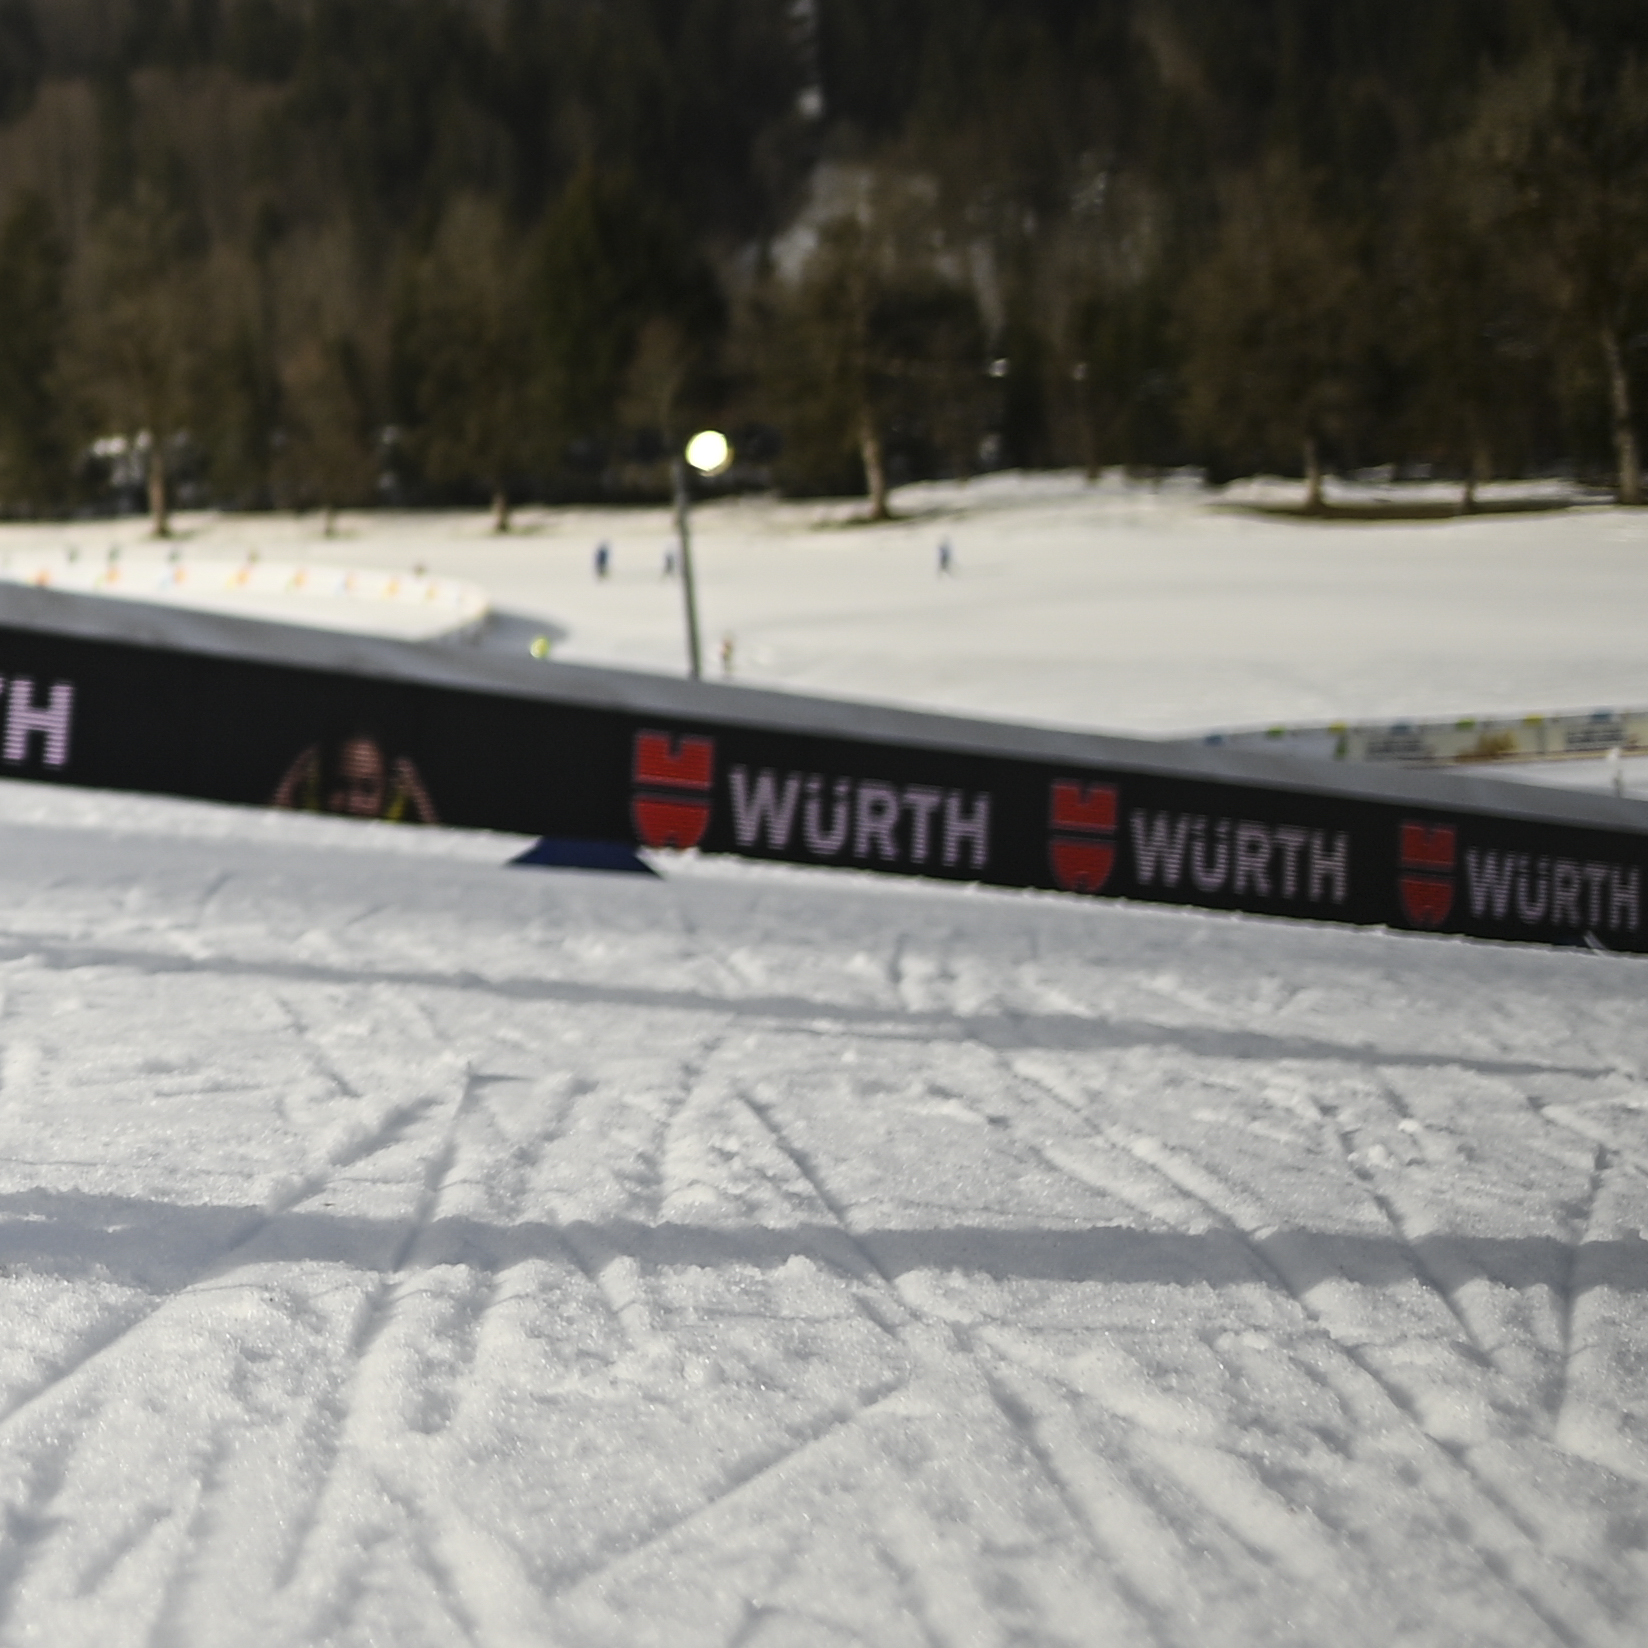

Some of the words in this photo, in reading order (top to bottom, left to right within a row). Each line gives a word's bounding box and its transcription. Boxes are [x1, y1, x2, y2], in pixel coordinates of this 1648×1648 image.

[728, 764, 991, 870] WÜRTH
[1130, 808, 1349, 904] WÜRTH
[1465, 845, 1640, 931] WÜRTH
